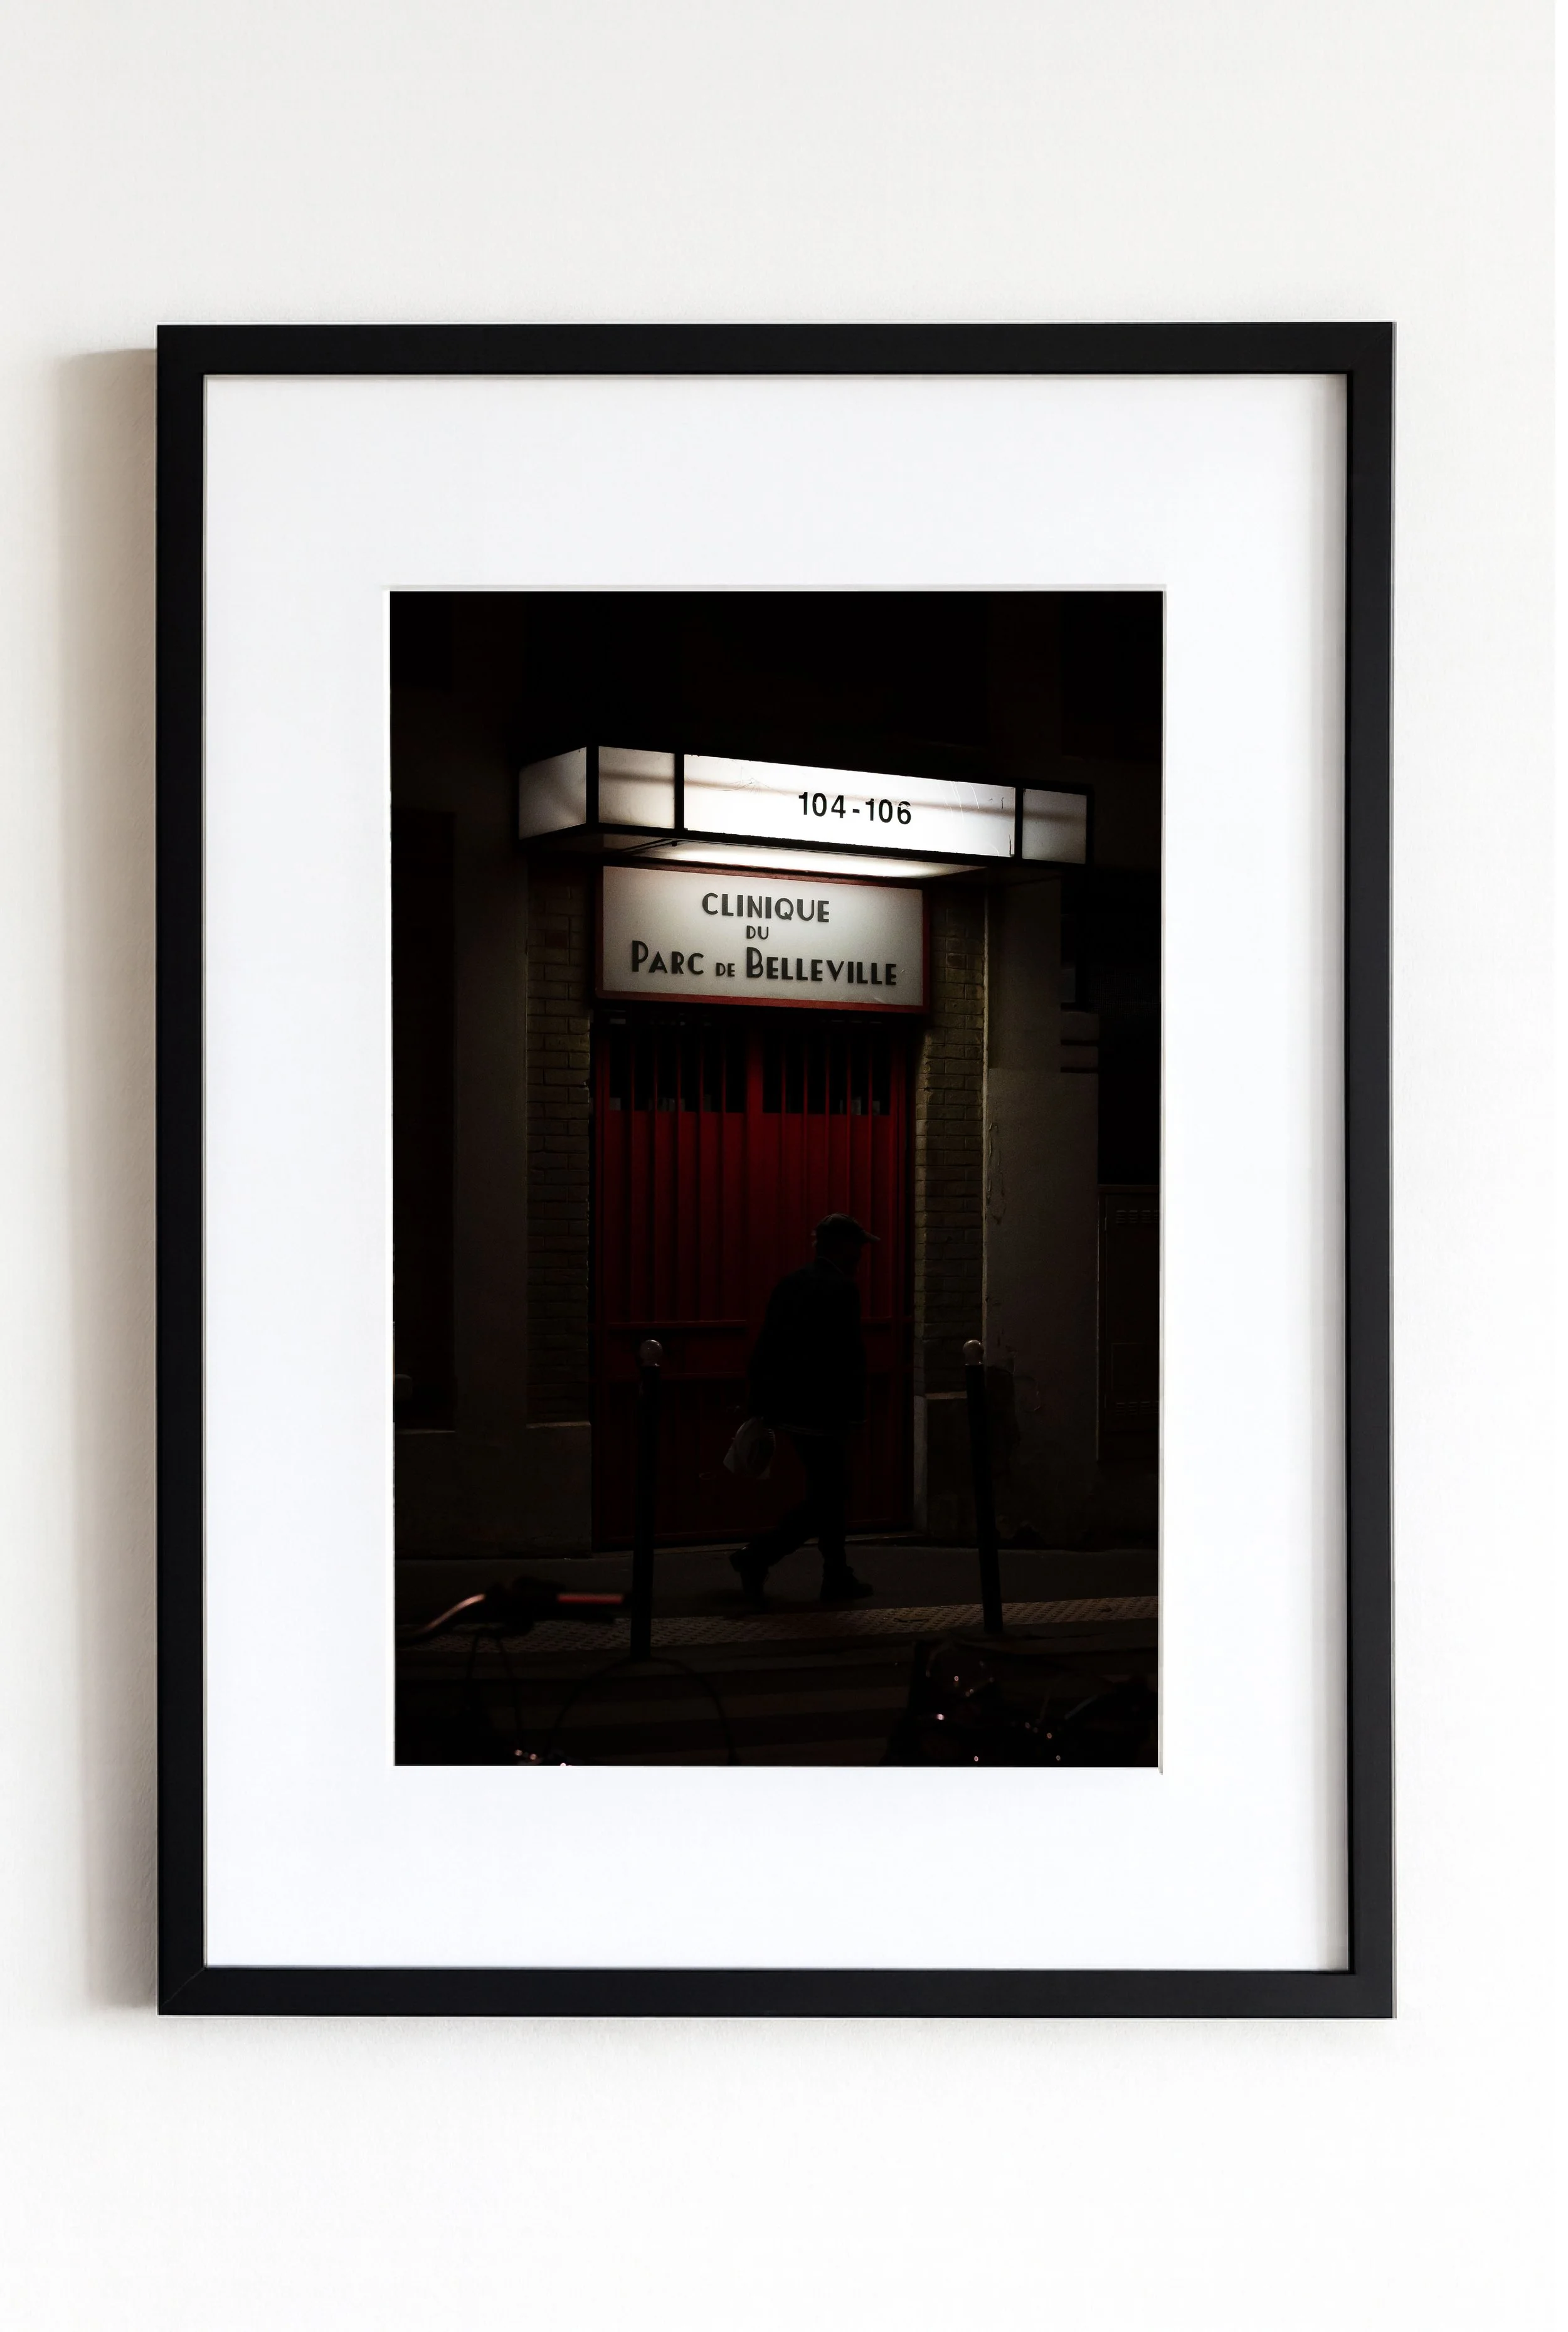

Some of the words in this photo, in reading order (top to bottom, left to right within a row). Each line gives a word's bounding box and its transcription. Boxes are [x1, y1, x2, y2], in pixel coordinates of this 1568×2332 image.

[798, 792, 911, 825] 104-106
[702, 893, 829, 923] CLINIQUE
[746, 925, 769, 940] DU
[631, 940, 704, 976] PARC
[714, 962, 736, 978] DE
[746, 946, 897, 987] BELLEVILLE
